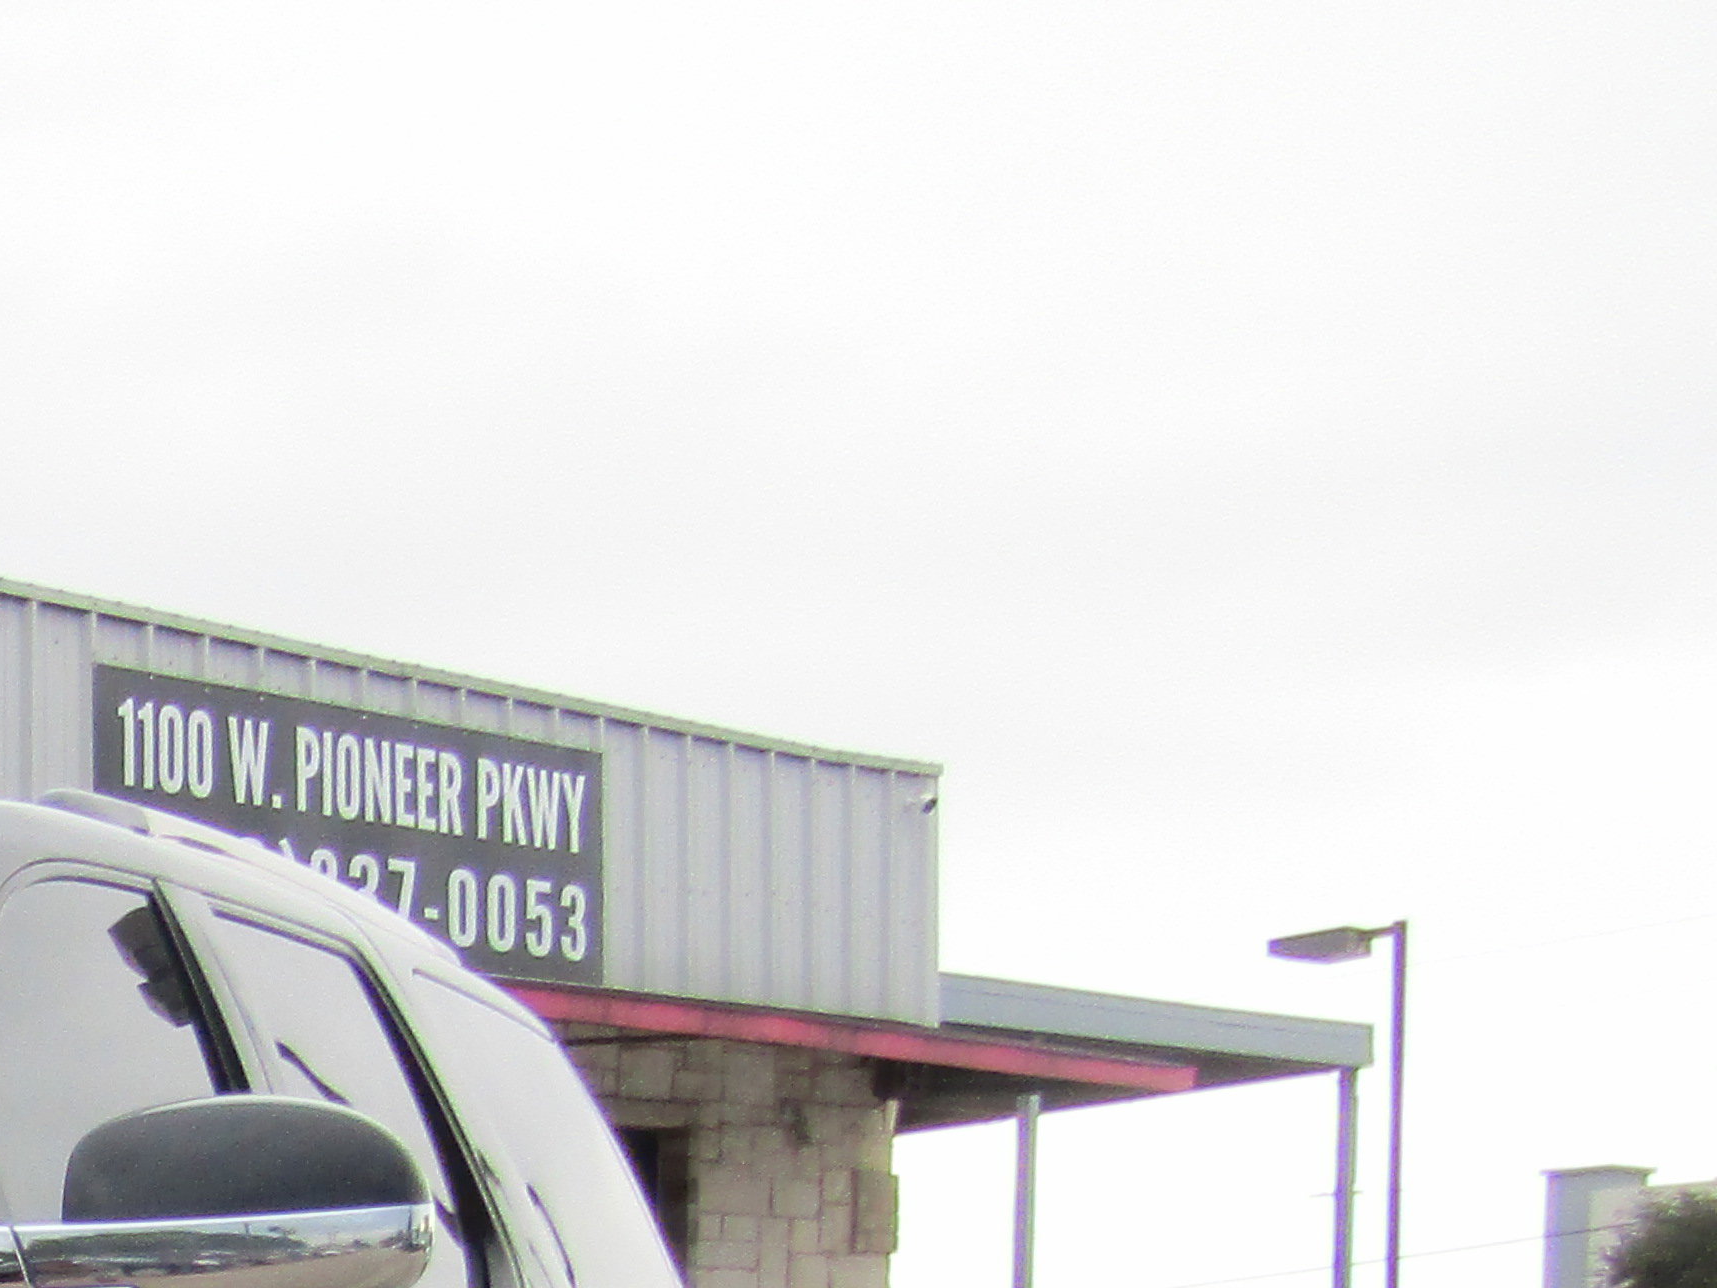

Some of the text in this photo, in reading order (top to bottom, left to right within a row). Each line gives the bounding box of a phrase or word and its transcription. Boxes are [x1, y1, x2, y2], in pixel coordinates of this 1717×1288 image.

[116, 697, 587, 855] 1100 W. PIONEER PKWY
